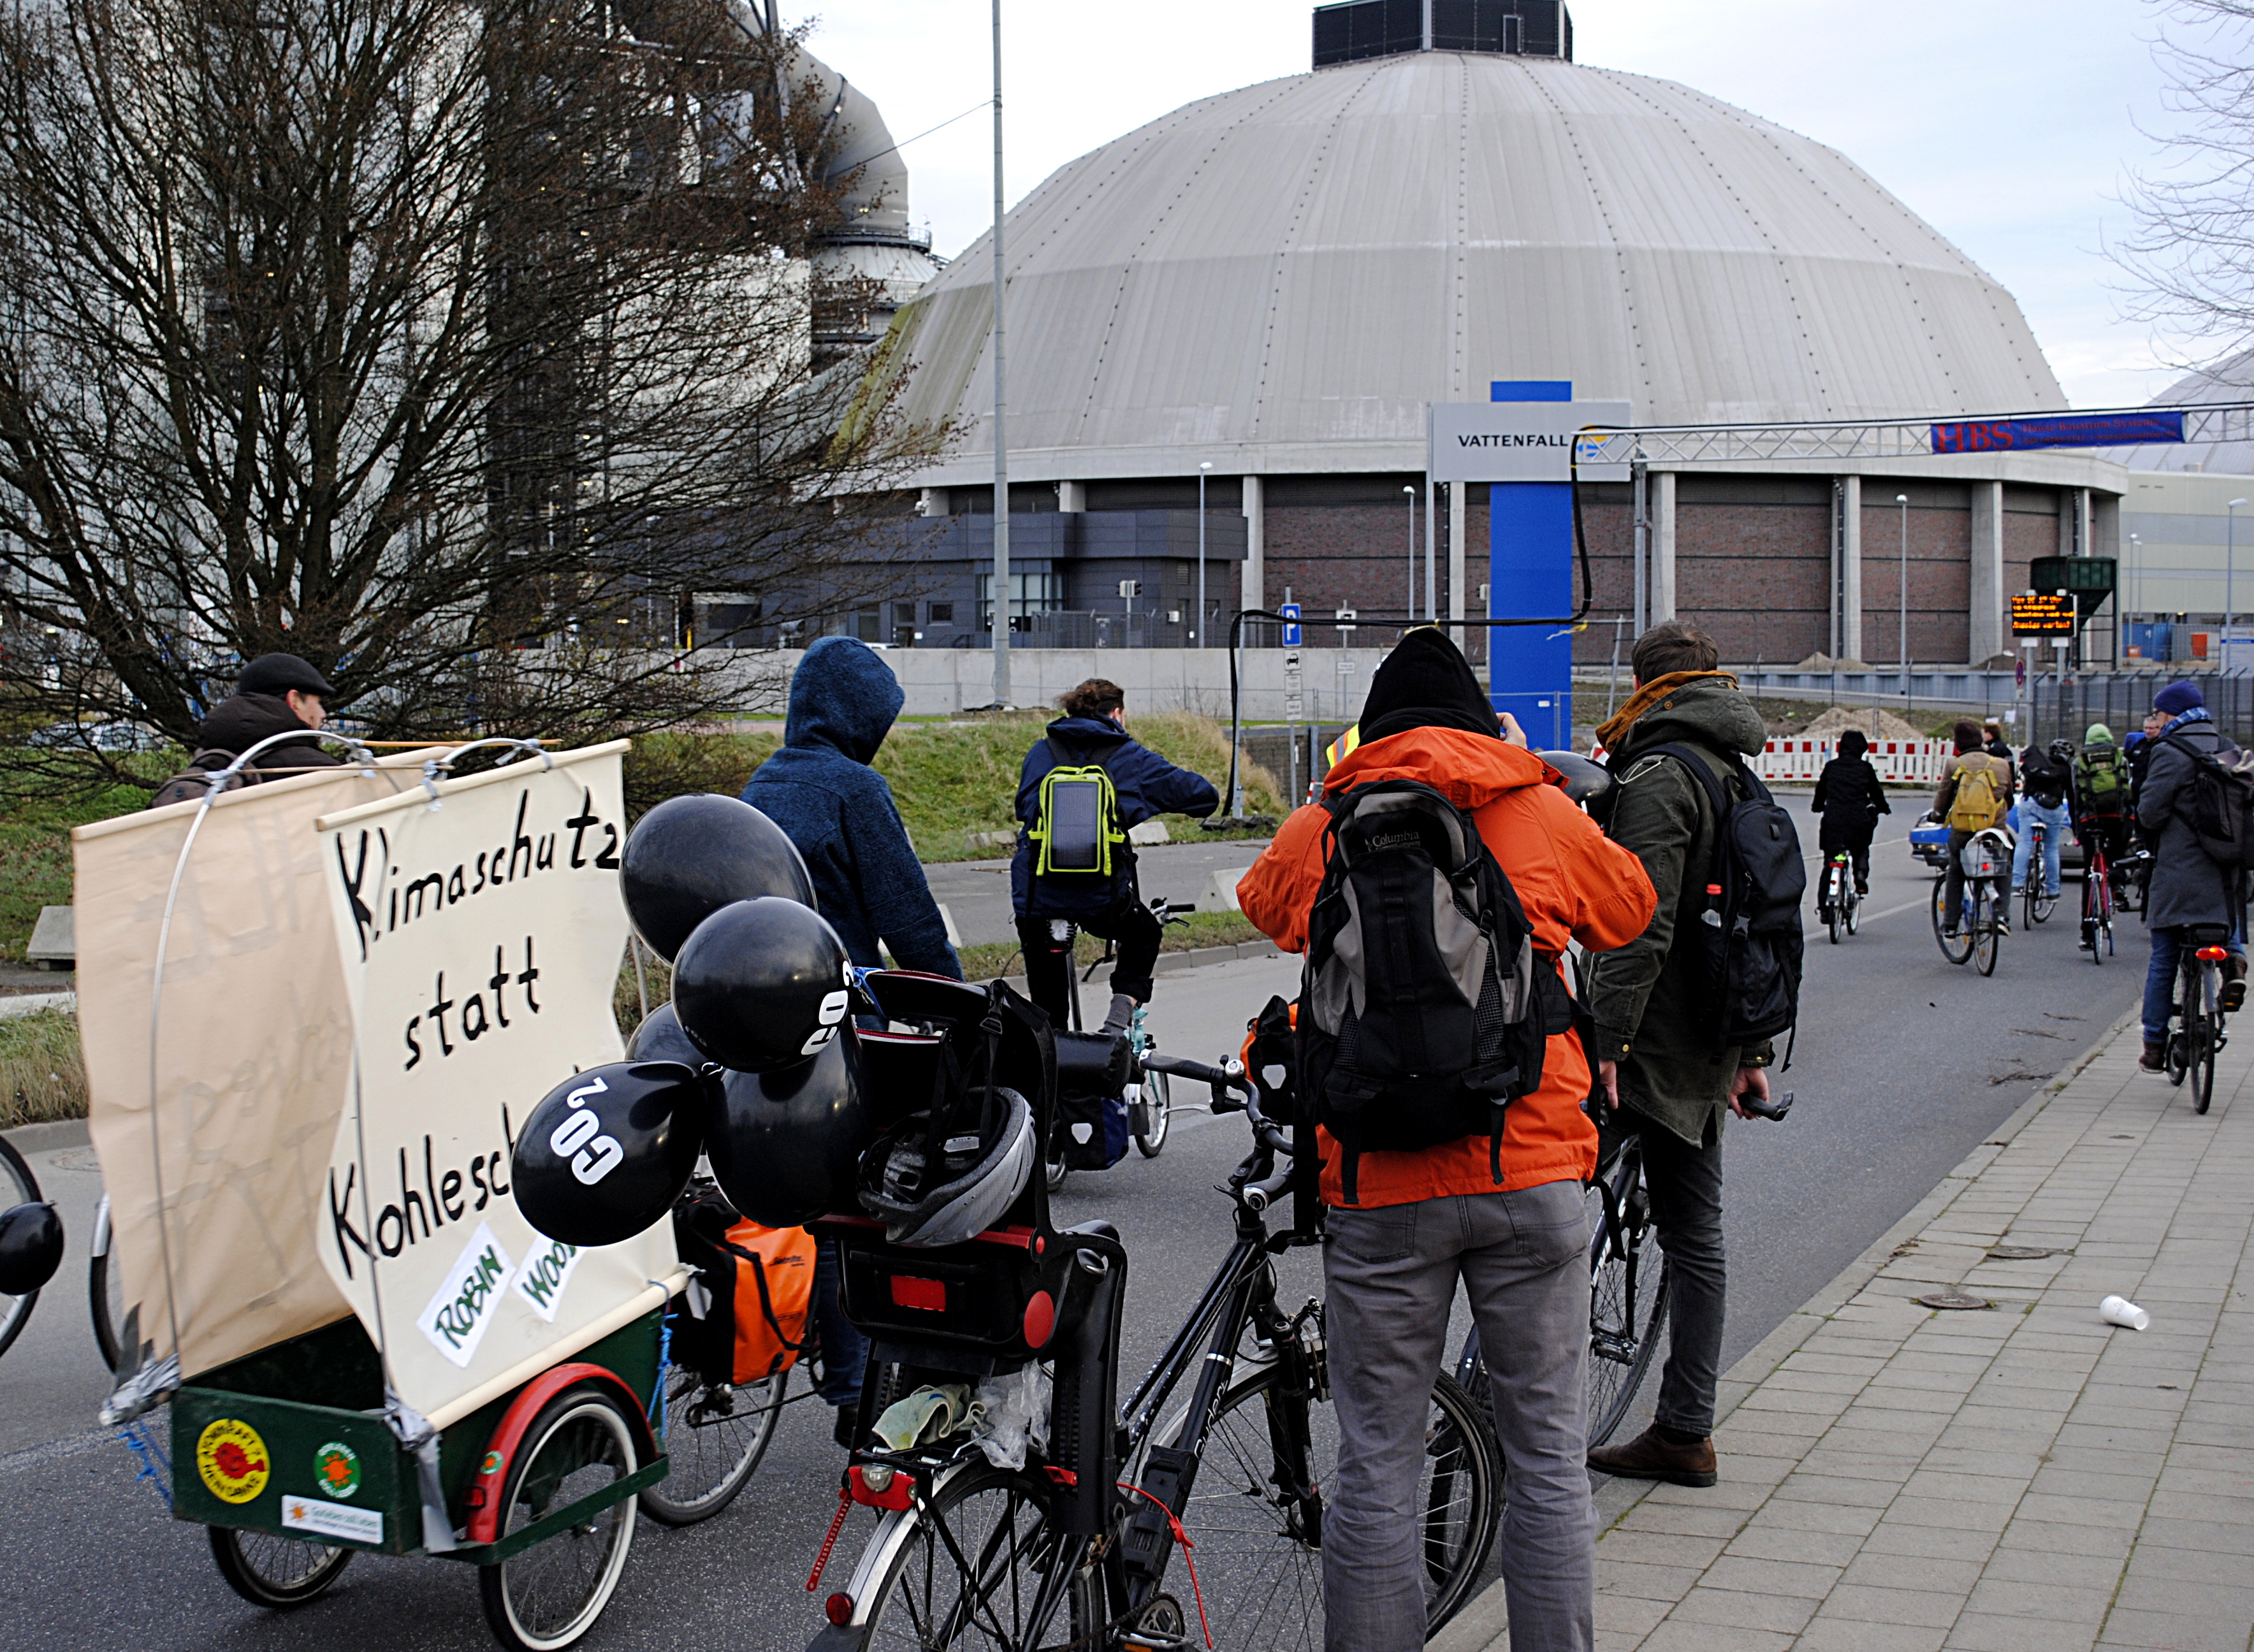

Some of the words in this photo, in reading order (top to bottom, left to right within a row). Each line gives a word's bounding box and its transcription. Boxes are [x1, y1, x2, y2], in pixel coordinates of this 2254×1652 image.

[1458, 435, 1568, 447] VATTENFALL
[1937, 421, 2014, 453] HBS
[1286, 609, 1297, 641] P
[335, 785, 620, 963] Klimaschutz
[1372, 830, 1420, 848] Columbia
[404, 935, 540, 1072] statt
[550, 1076, 624, 1186] CO2
[433, 1243, 504, 1350] ROBIN
[521, 1240, 578, 1310] WOO
